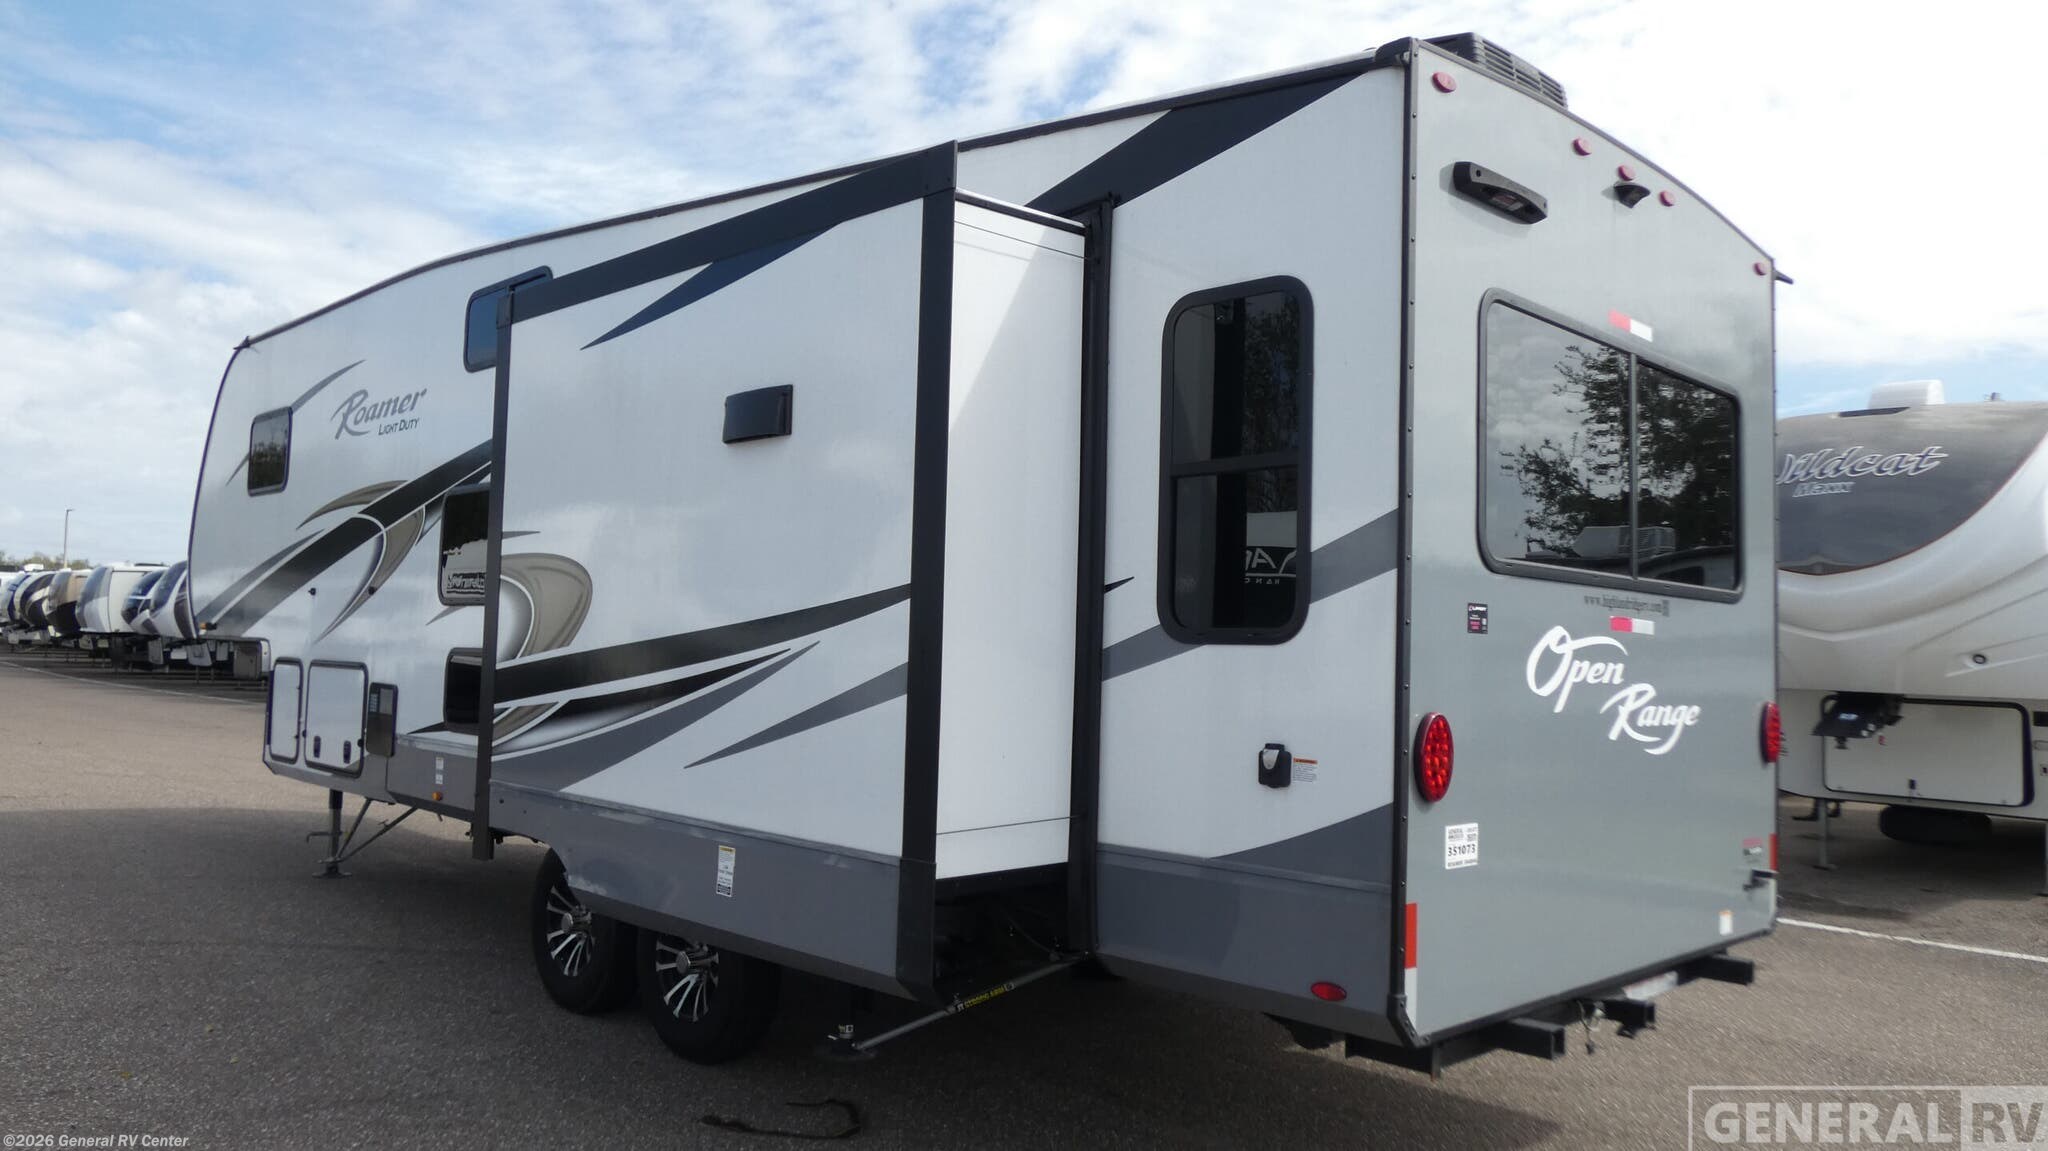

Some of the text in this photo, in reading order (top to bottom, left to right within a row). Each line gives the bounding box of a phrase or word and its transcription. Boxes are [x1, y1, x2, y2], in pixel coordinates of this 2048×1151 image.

[330, 387, 427, 440] Roamer
[1526, 625, 1629, 713] Open
[1599, 682, 1701, 755] Range
[1447, 843, 1476, 857] 351073
